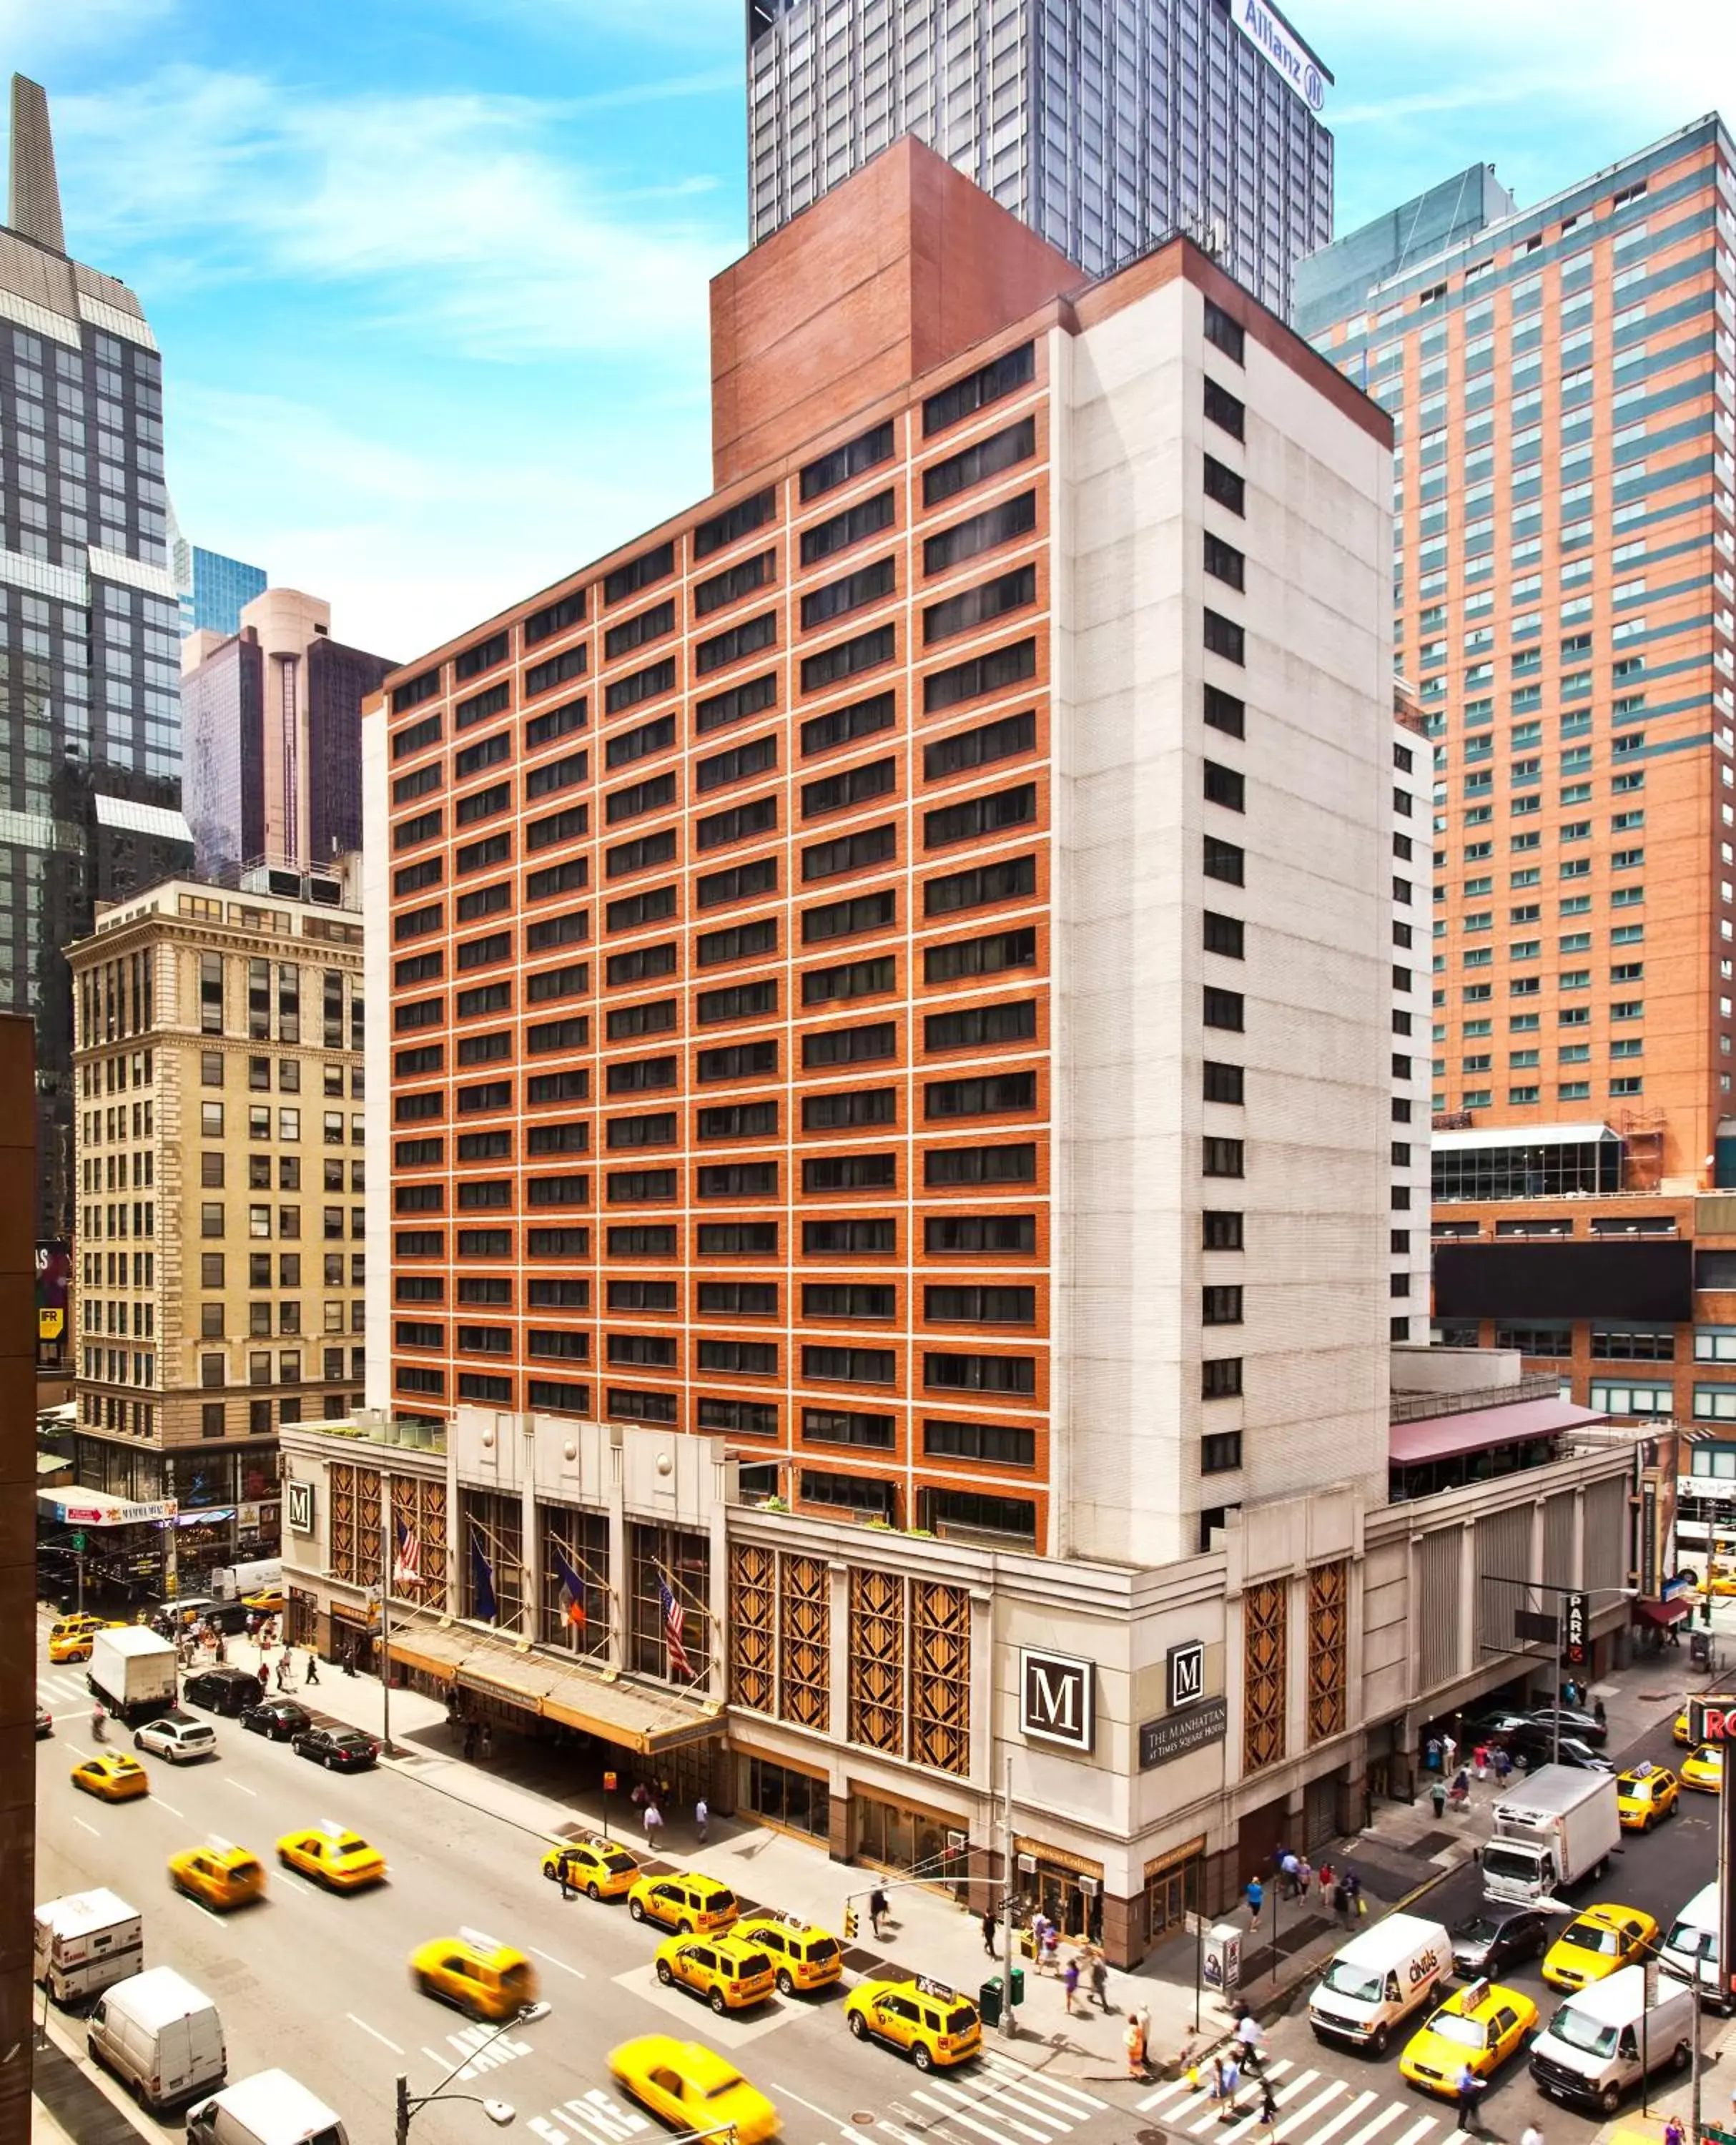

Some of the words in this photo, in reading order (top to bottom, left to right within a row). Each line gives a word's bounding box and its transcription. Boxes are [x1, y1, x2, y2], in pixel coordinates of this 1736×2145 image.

[1244, 0, 1301, 84] Allianz
[290, 1489, 307, 1524] M
[1570, 1596, 1582, 1645] PARK
[1178, 1655, 1200, 1695] M
[1030, 1666, 1080, 1732] M
[1148, 1730, 1168, 1748] THE
[1169, 1708, 1225, 1740] MANHATTAN
[1158, 1740, 1178, 1757] TIMES
[1178, 1731, 1204, 1749] SQUARE
[1204, 1722, 1225, 1737] HOTEL
[420, 2023, 534, 2081] LANE
